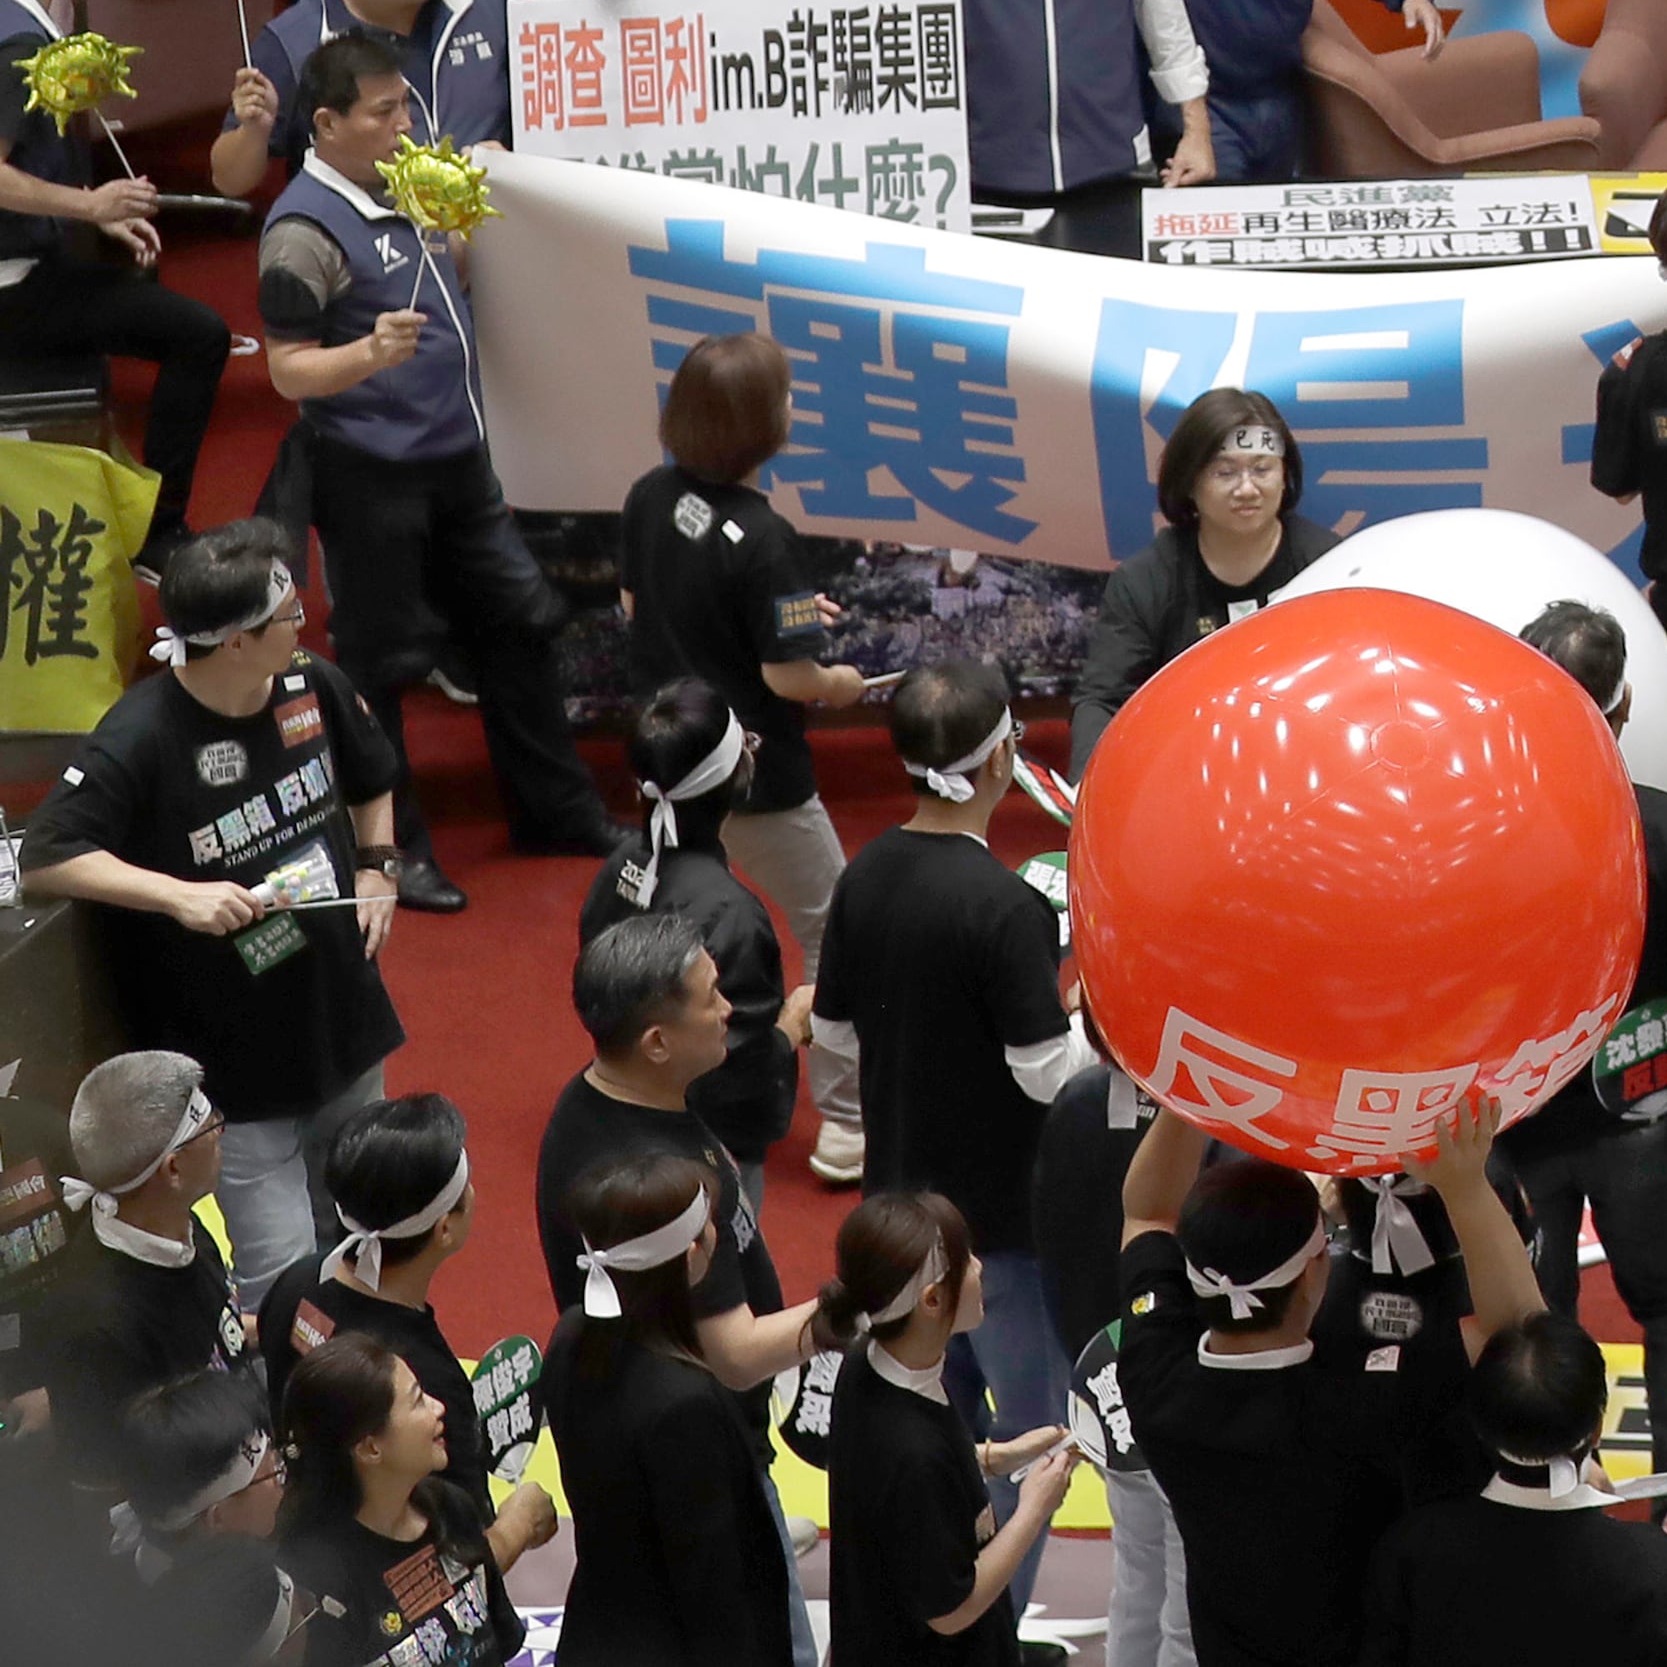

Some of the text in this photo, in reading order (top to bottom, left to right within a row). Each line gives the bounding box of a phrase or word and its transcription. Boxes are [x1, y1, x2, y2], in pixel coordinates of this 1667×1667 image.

[519, 2, 958, 133] 調查 圖利im.B詐騙集團
[1281, 184, 1455, 208] 民進黨
[1153, 201, 1579, 237] 拖延再生醫療法 立法!
